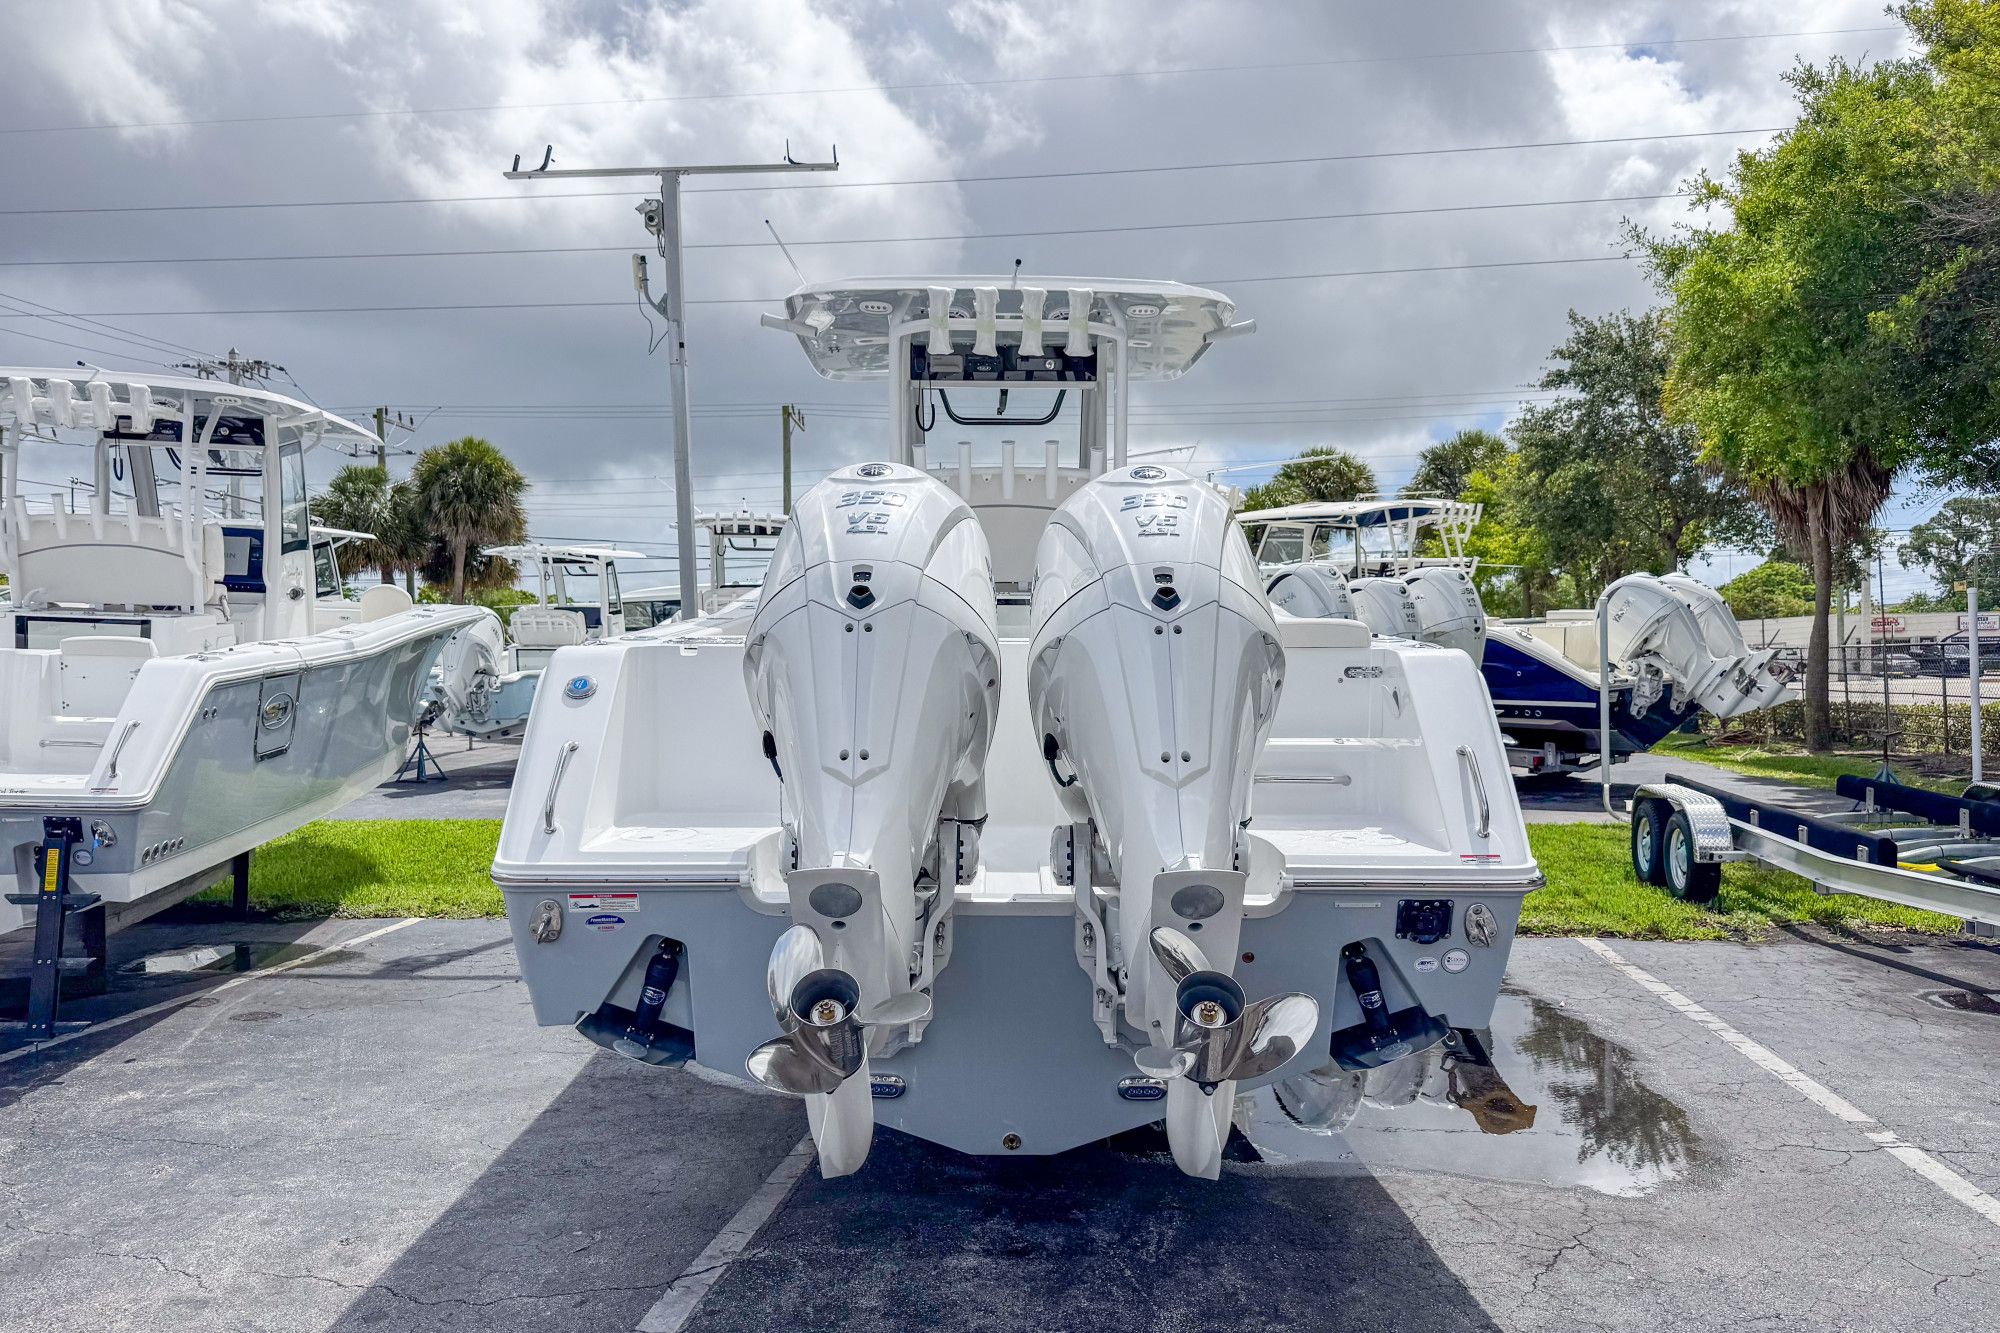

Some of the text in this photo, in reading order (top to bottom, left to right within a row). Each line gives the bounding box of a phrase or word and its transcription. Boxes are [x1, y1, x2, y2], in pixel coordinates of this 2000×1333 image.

[836, 489, 908, 509] 350
[847, 511, 890, 525] V6
[1135, 514, 1178, 528] V6
